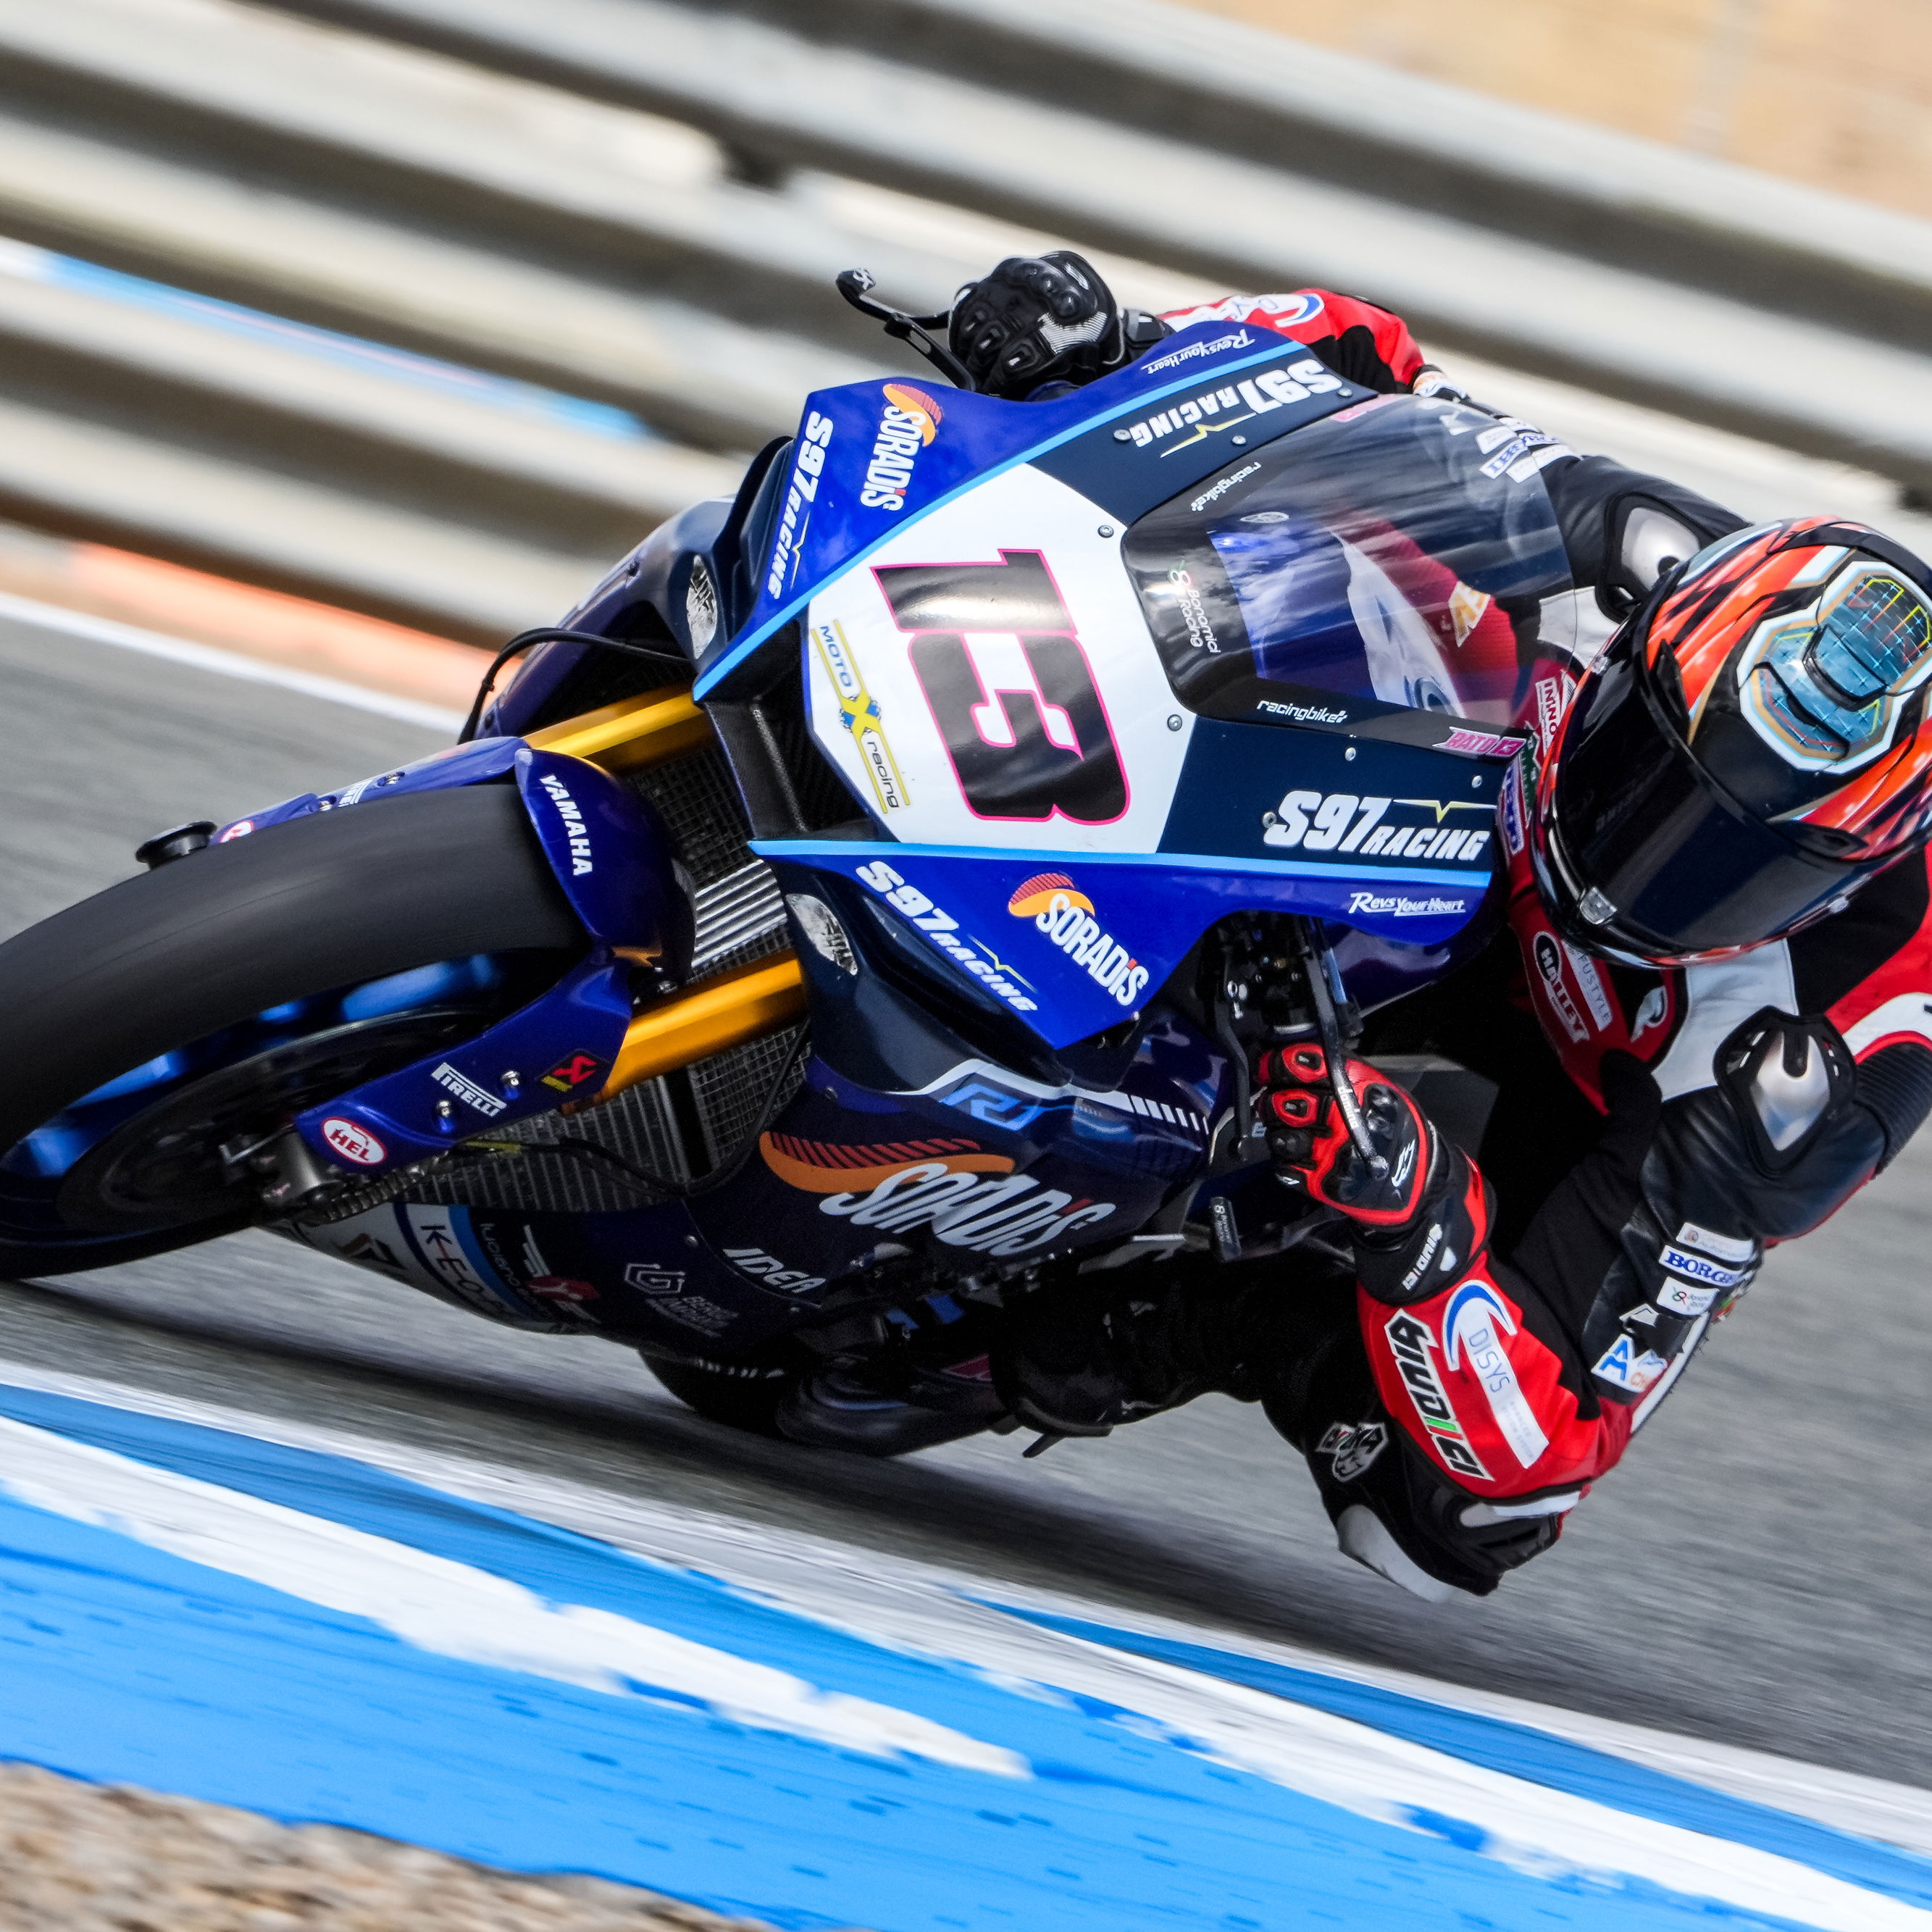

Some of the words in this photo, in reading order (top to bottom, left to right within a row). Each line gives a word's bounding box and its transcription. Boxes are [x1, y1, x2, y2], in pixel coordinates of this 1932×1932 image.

[819, 624, 853, 688] MOTO
[866, 740, 900, 809] racing
[870, 548, 1131, 826] 13
[540, 774, 593, 875] YAMAHA
[432, 1062, 506, 1117] PIRELLI
[327, 1127, 374, 1162] HEL
[1468, 1326, 1512, 1394] DISYS
